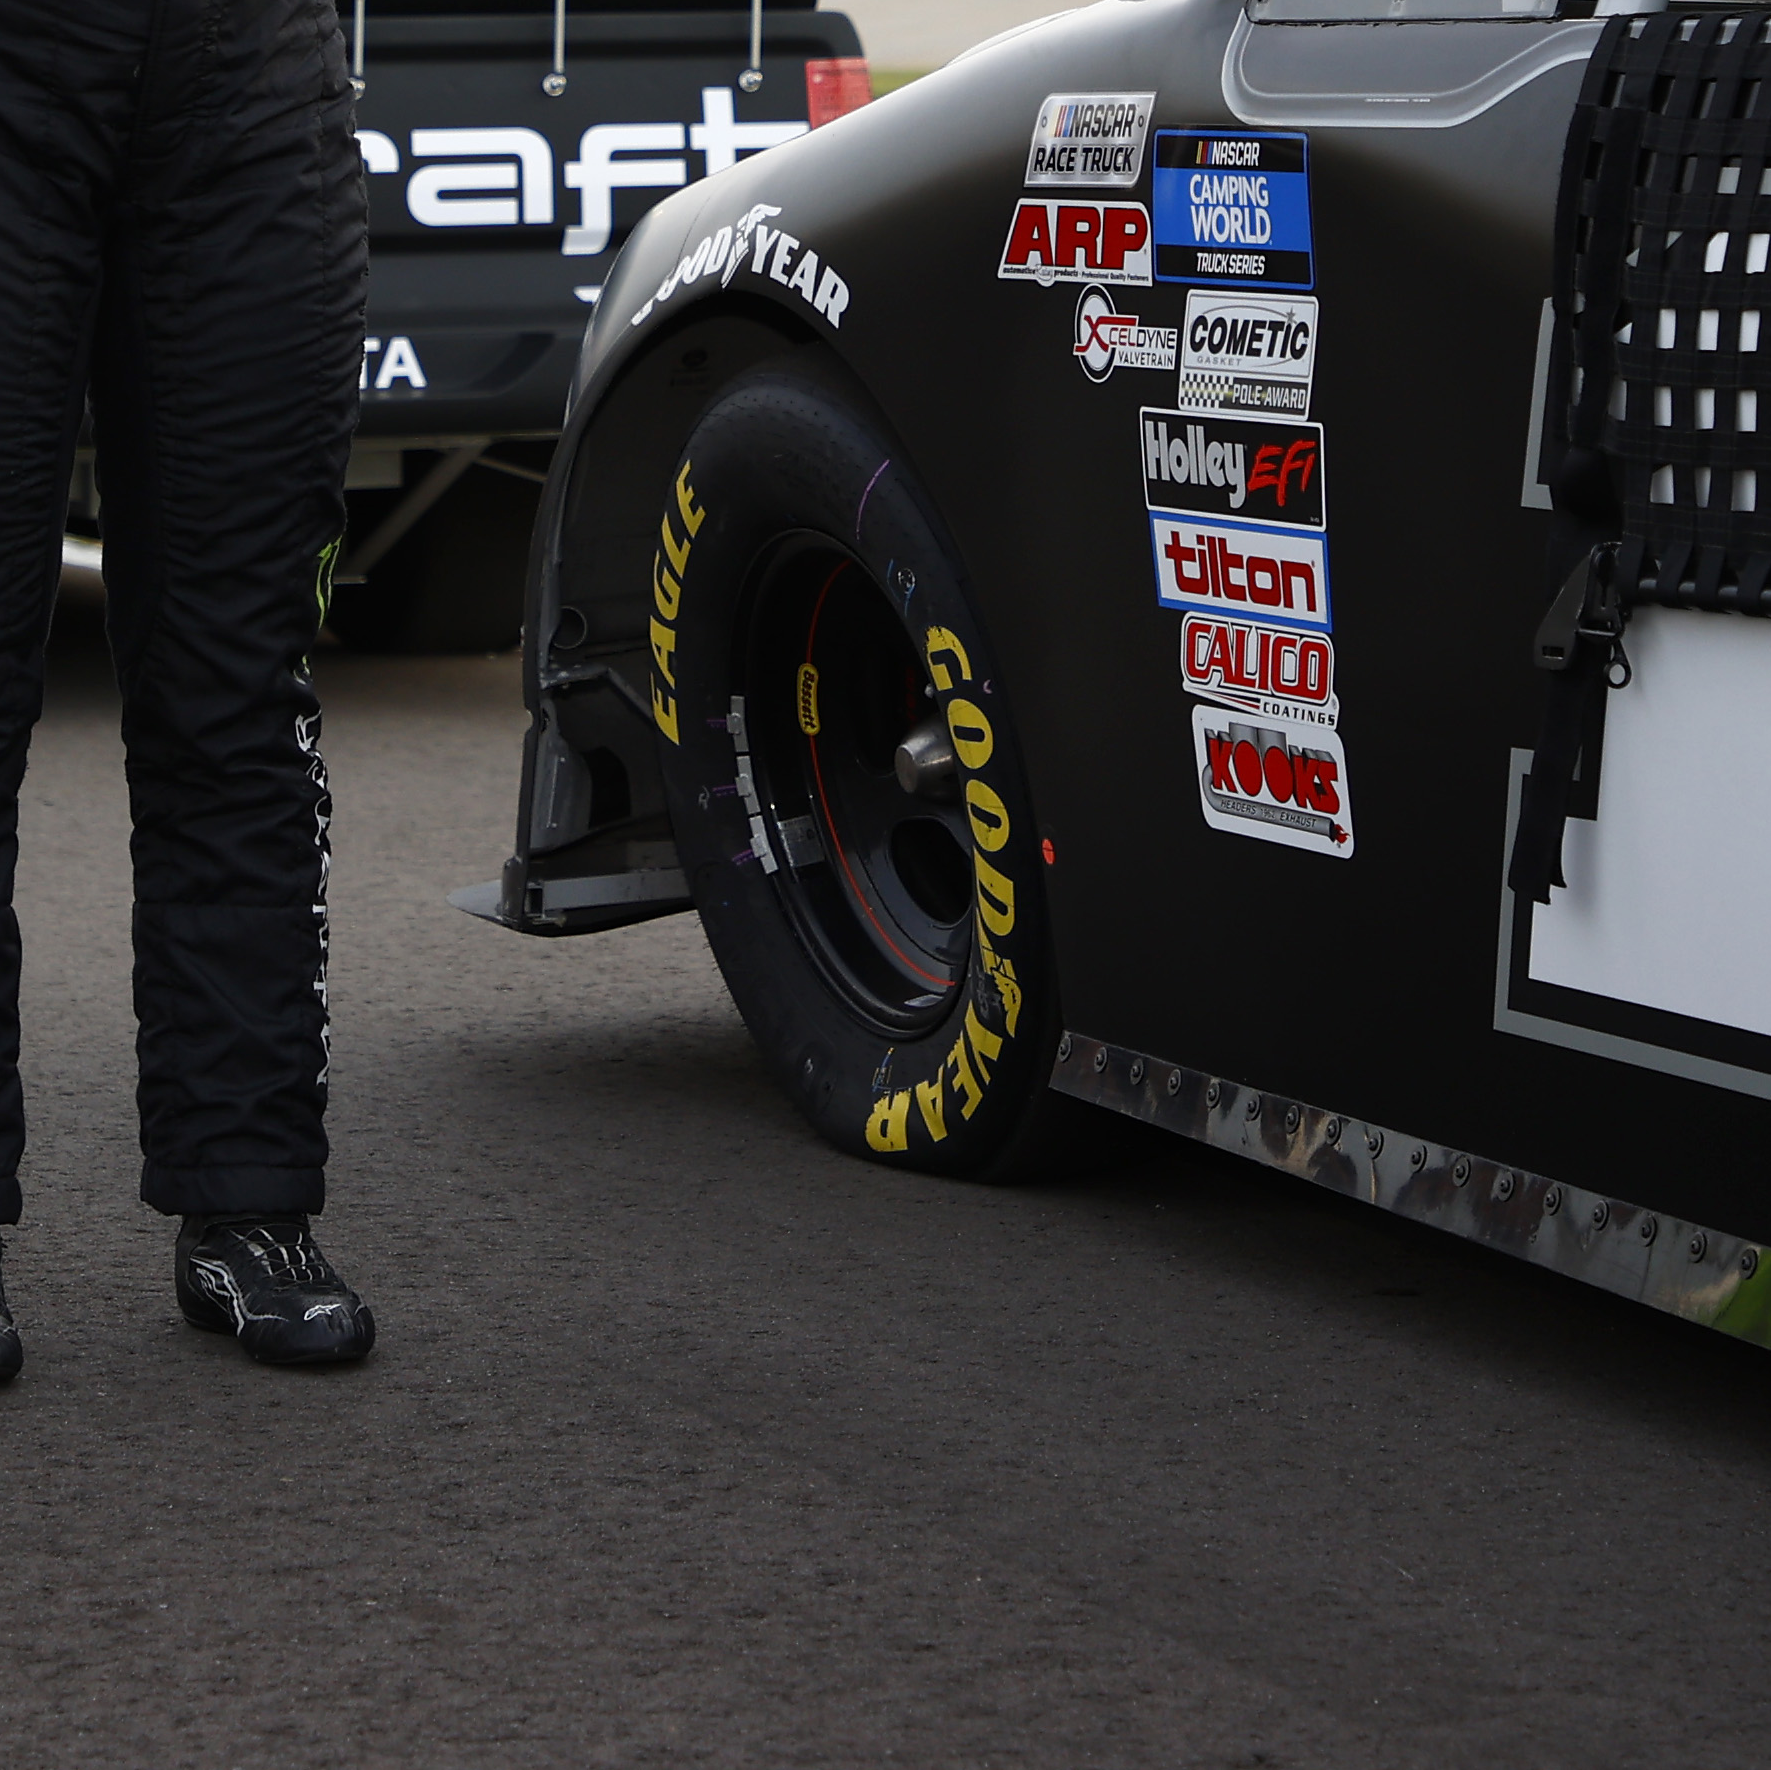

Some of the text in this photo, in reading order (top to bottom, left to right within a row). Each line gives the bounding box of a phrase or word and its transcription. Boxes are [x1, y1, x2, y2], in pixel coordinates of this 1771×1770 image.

[1068, 103, 1136, 138] NASCAR
[1033, 146, 1135, 173] RACE TRUCK
[1211, 140, 1260, 167] NASCAR
[1189, 174, 1269, 207] CAMPING
[1005, 204, 1148, 270] ARP
[1190, 205, 1272, 245] WORLD
[1196, 252, 1266, 276] TRUCK SERIES
[1074, 315, 1177, 352] XCELDYNE
[1189, 314, 1310, 362] COMETIC
[1118, 350, 1173, 367] VALVETRAIN
[1196, 355, 1242, 367] GASKET
[1232, 382, 1306, 410] POLE AWARD
[1145, 420, 1247, 508] Holley
[1164, 531, 1317, 612] tilton
[648, 460, 706, 746] EAGLE
[1184, 621, 1332, 704] CALICO
[801, 670, 818, 730] Bassett
[1263, 700, 1335, 728] COATINGS
[1206, 730, 1341, 815] KOOKS
[1220, 799, 1257, 814] HEADERS
[1280, 811, 1317, 828] EXHAUST
[866, 625, 1020, 1152] GOODYEAR
